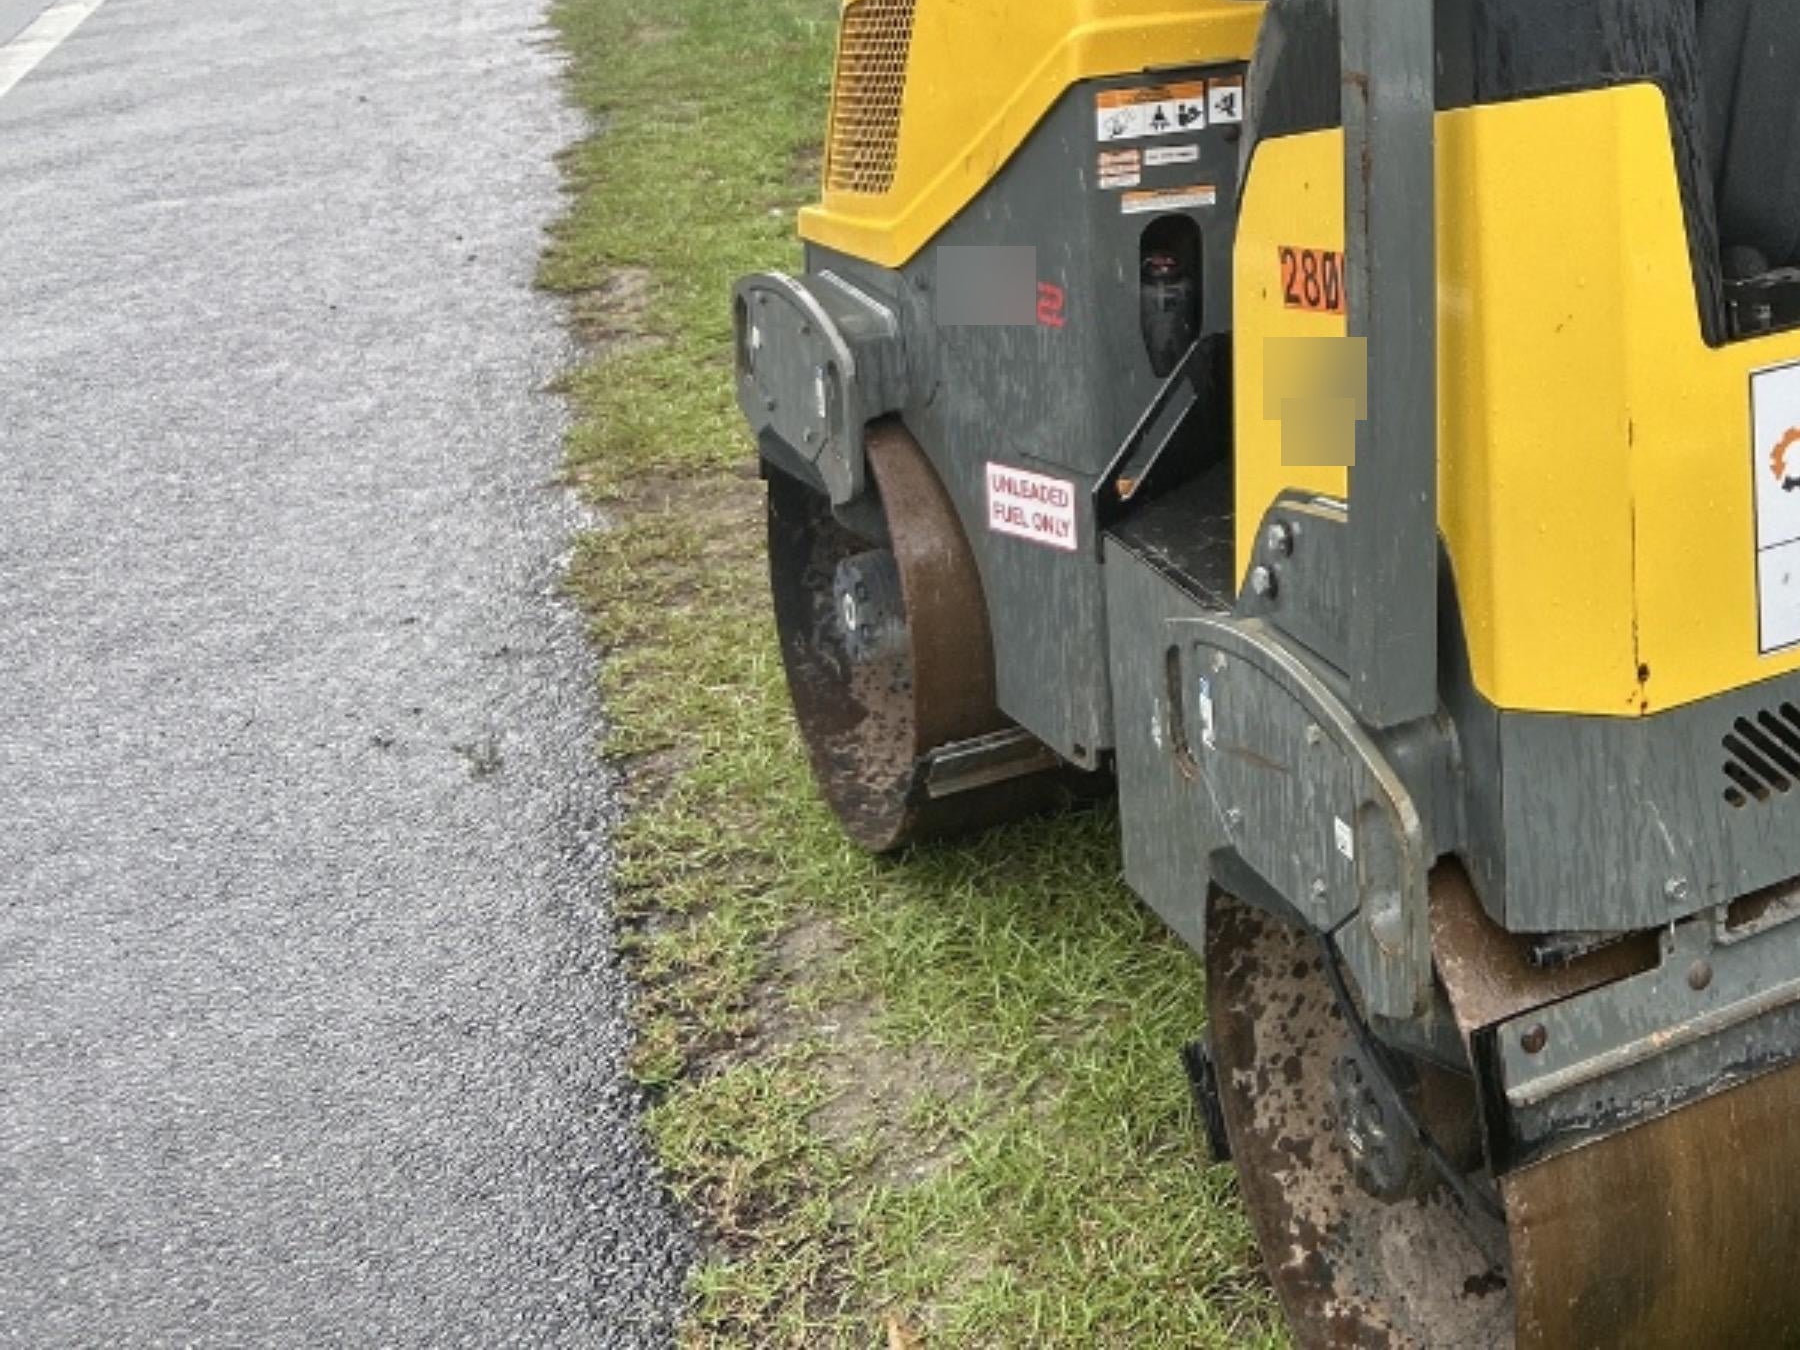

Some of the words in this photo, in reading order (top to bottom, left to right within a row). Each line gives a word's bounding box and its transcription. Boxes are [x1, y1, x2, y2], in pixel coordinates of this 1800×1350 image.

[992, 473, 1069, 508] UNLEADED
[992, 500, 1030, 529] FUEL
[1032, 511, 1071, 538] ONLY
